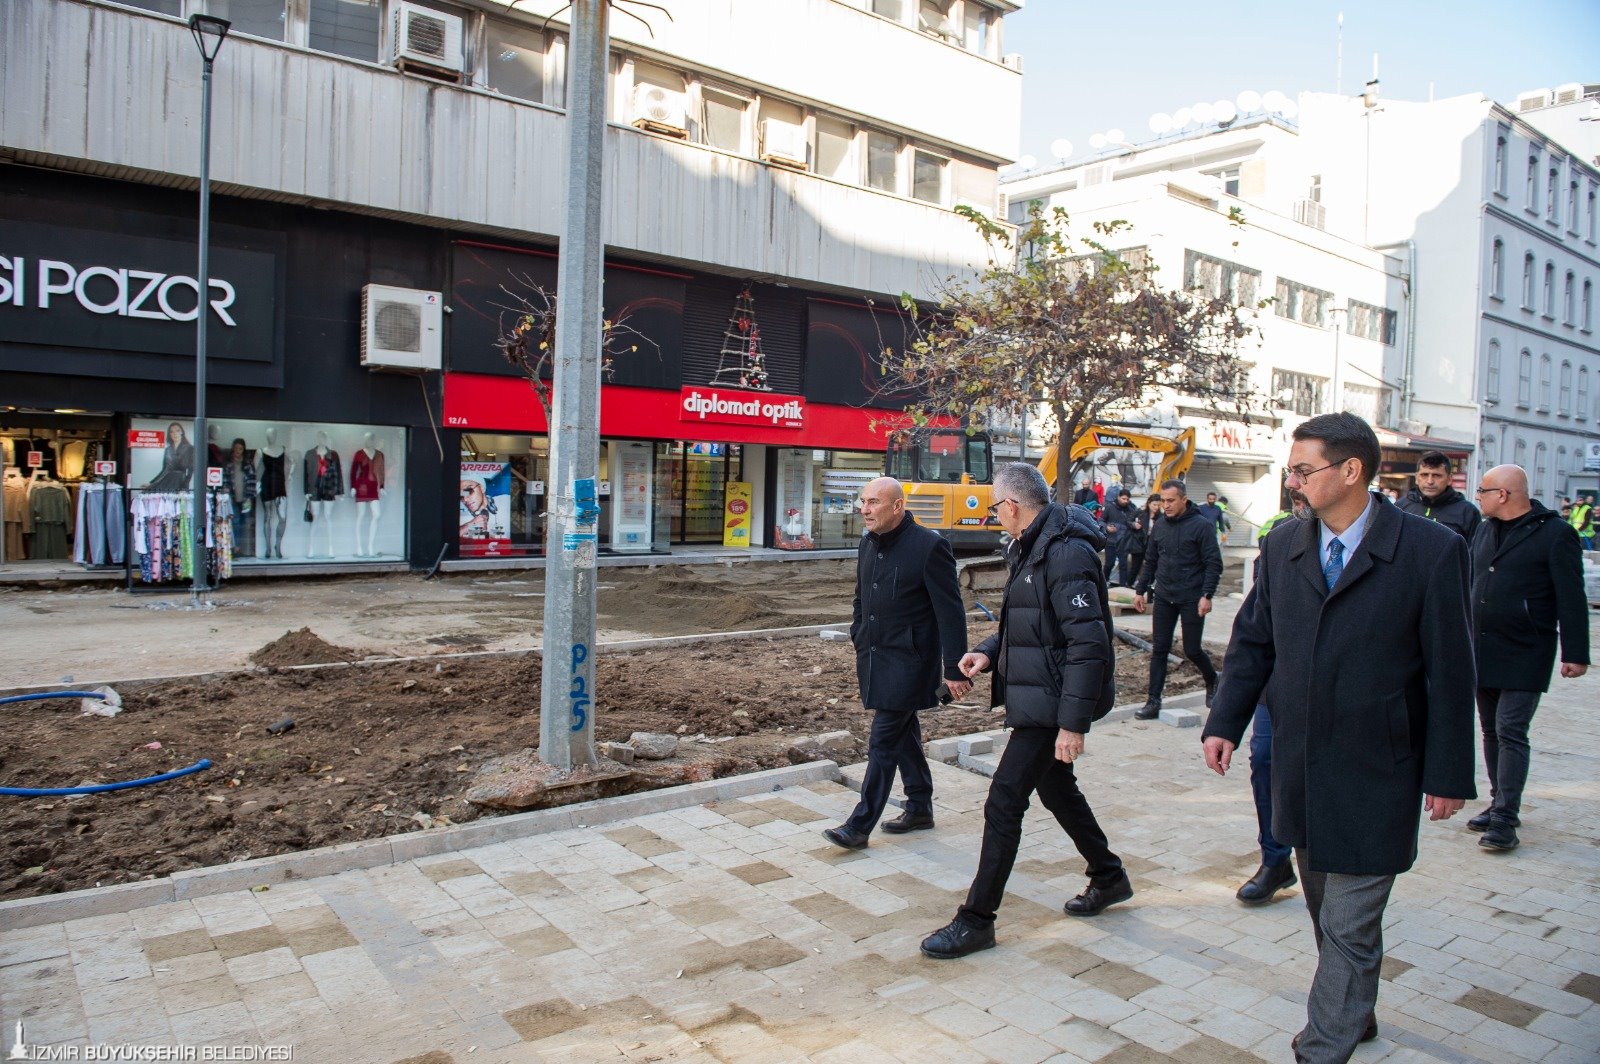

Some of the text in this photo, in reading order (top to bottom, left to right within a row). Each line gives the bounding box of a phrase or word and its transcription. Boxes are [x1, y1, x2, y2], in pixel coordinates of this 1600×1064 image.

[683, 391, 803, 424] diplomat optik
[448, 416, 468, 425] 12/A
[1100, 435, 1127, 446] SANY
[459, 463, 502, 471] ARRERA
